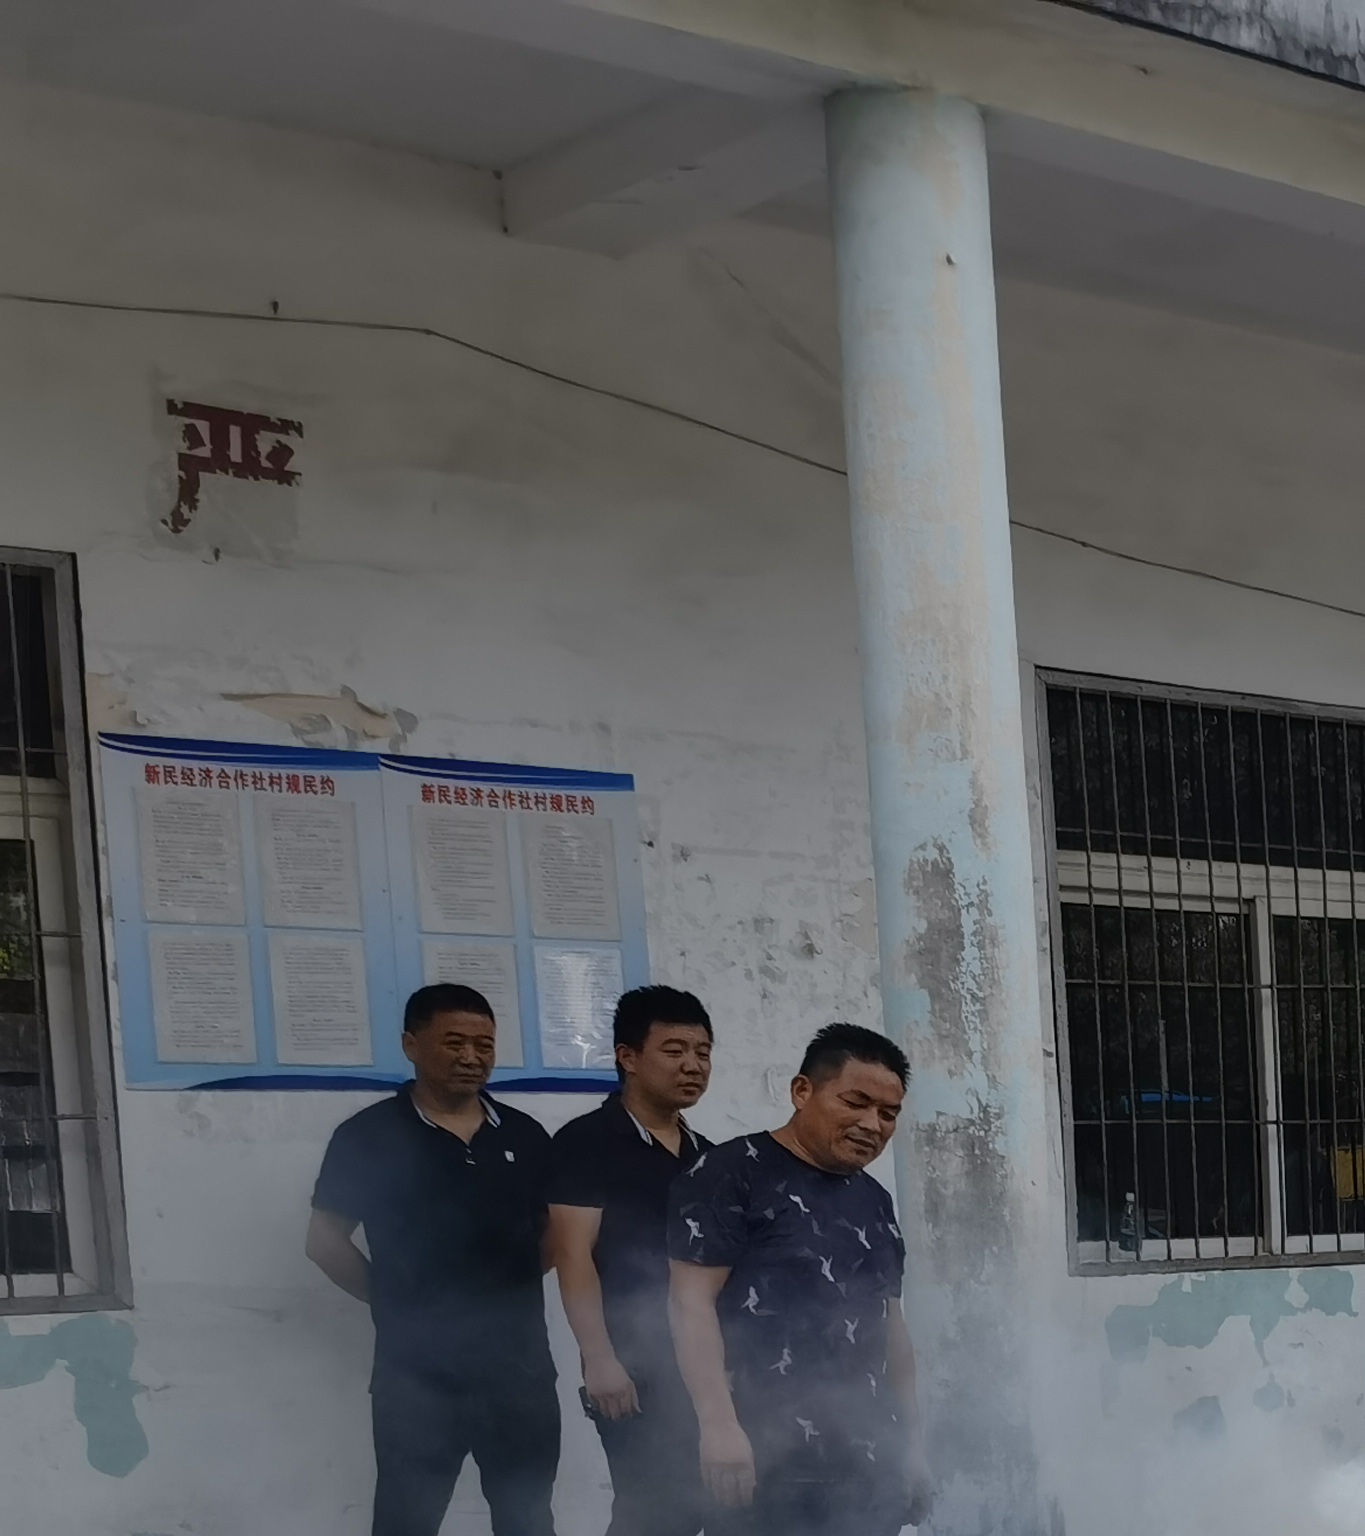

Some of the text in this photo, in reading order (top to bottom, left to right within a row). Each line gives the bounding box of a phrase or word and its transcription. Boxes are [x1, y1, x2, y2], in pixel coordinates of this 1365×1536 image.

[144, 762, 336, 797] 新民经济合作社村规民约
[420, 782, 595, 816] 新民经济合作社村规民约
